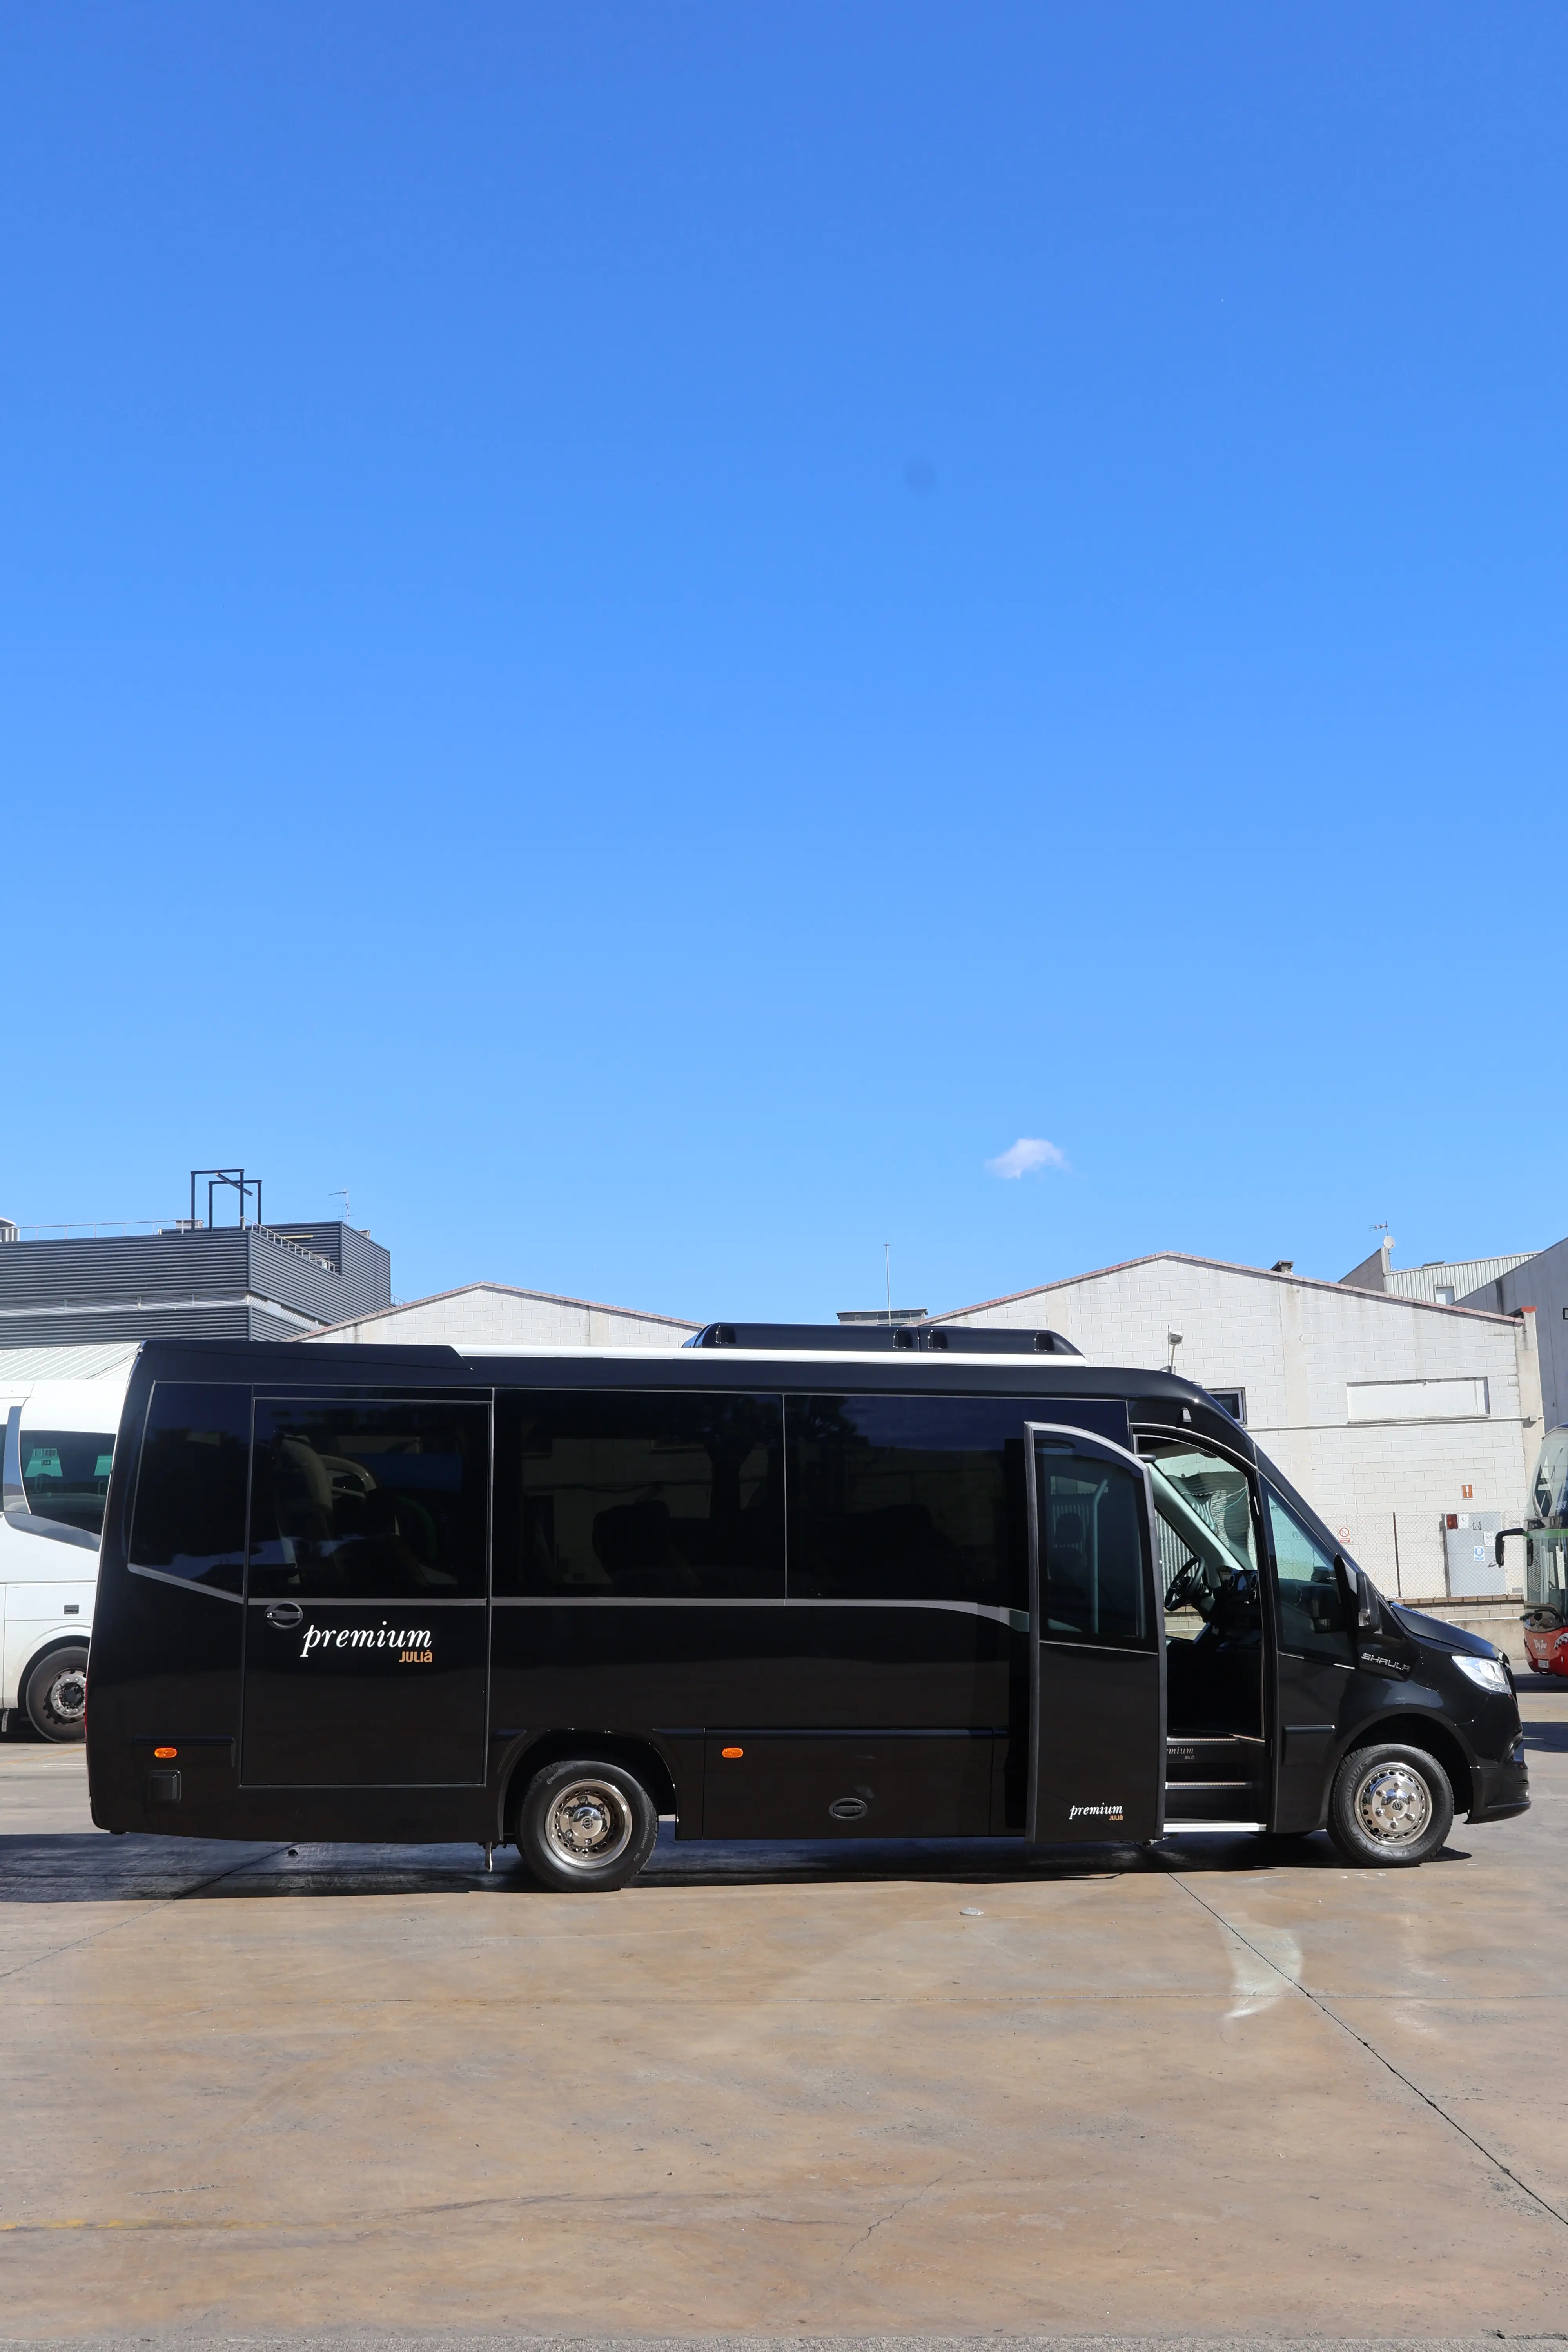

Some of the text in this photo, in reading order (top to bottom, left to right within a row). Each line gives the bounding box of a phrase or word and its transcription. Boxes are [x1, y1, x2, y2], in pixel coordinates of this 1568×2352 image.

[300, 1621, 432, 1657] premium
[1361, 1652, 1410, 1672] SHAULA
[1069, 1802, 1123, 1820] premium
